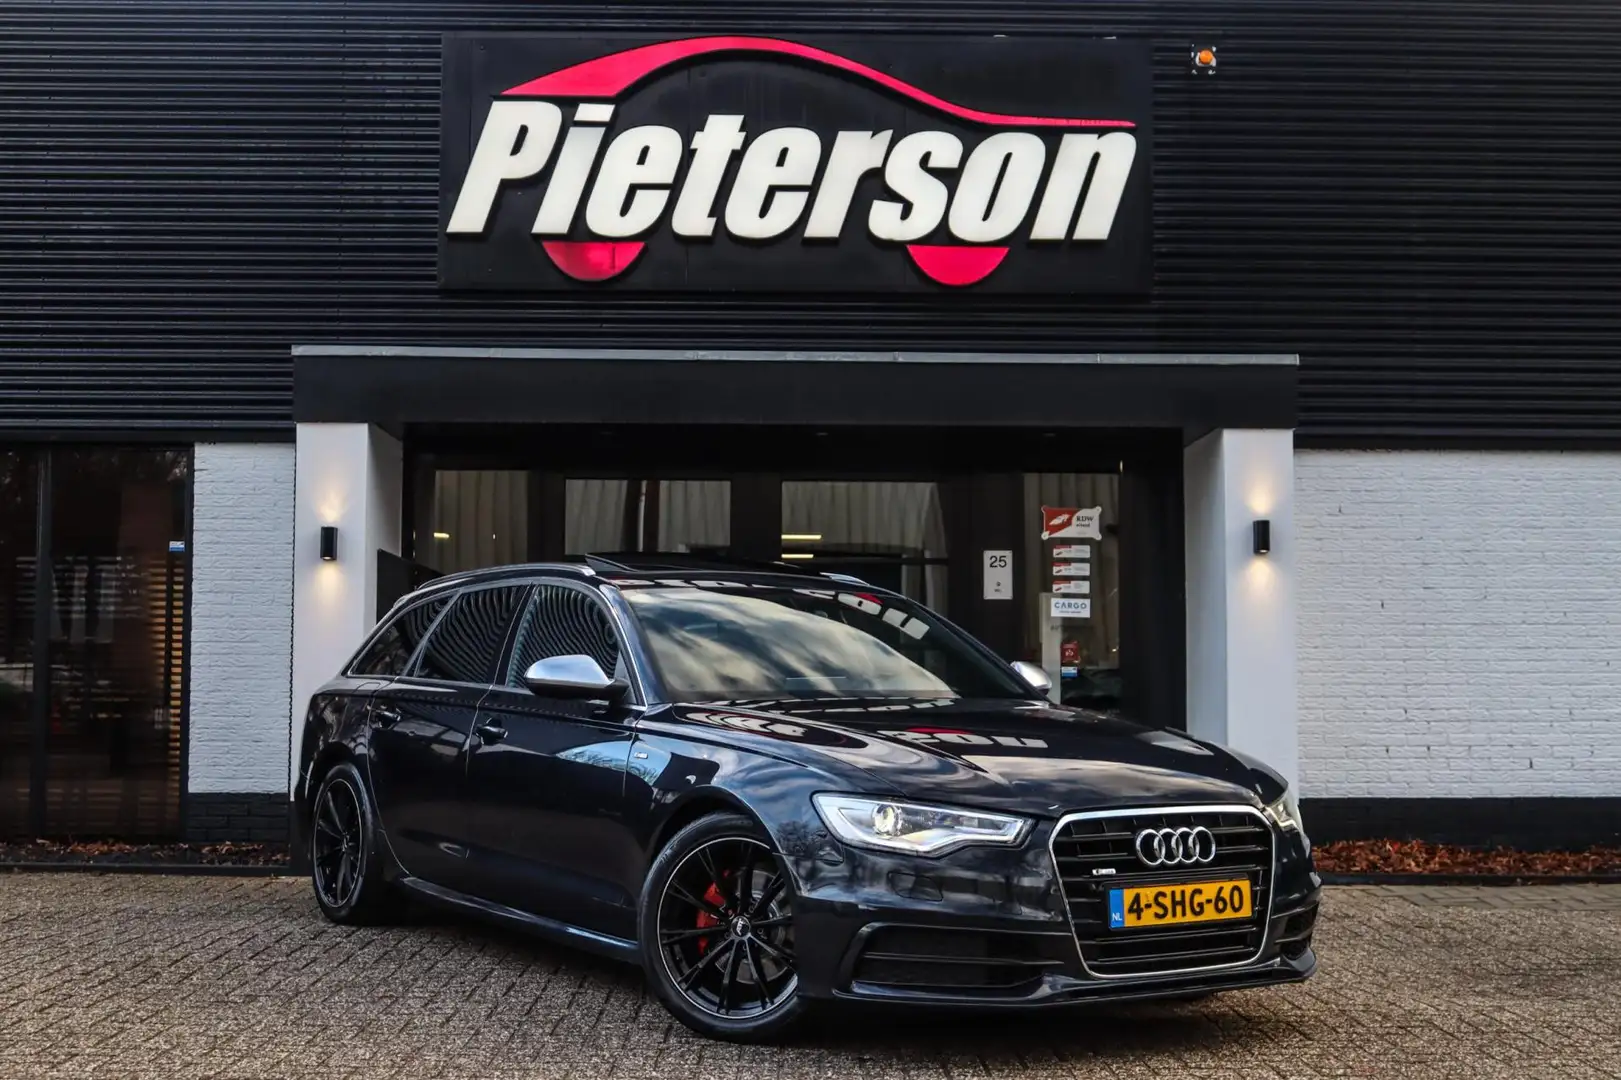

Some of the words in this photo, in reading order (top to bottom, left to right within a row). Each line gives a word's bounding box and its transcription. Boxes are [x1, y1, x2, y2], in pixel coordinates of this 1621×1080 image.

[446, 100, 1137, 242] Pieterson
[990, 555, 1007, 568] 25
[1054, 602, 1087, 610] CARGO
[1128, 885, 1244, 920] 4-SHG-60
[1112, 913, 1123, 921] NL
